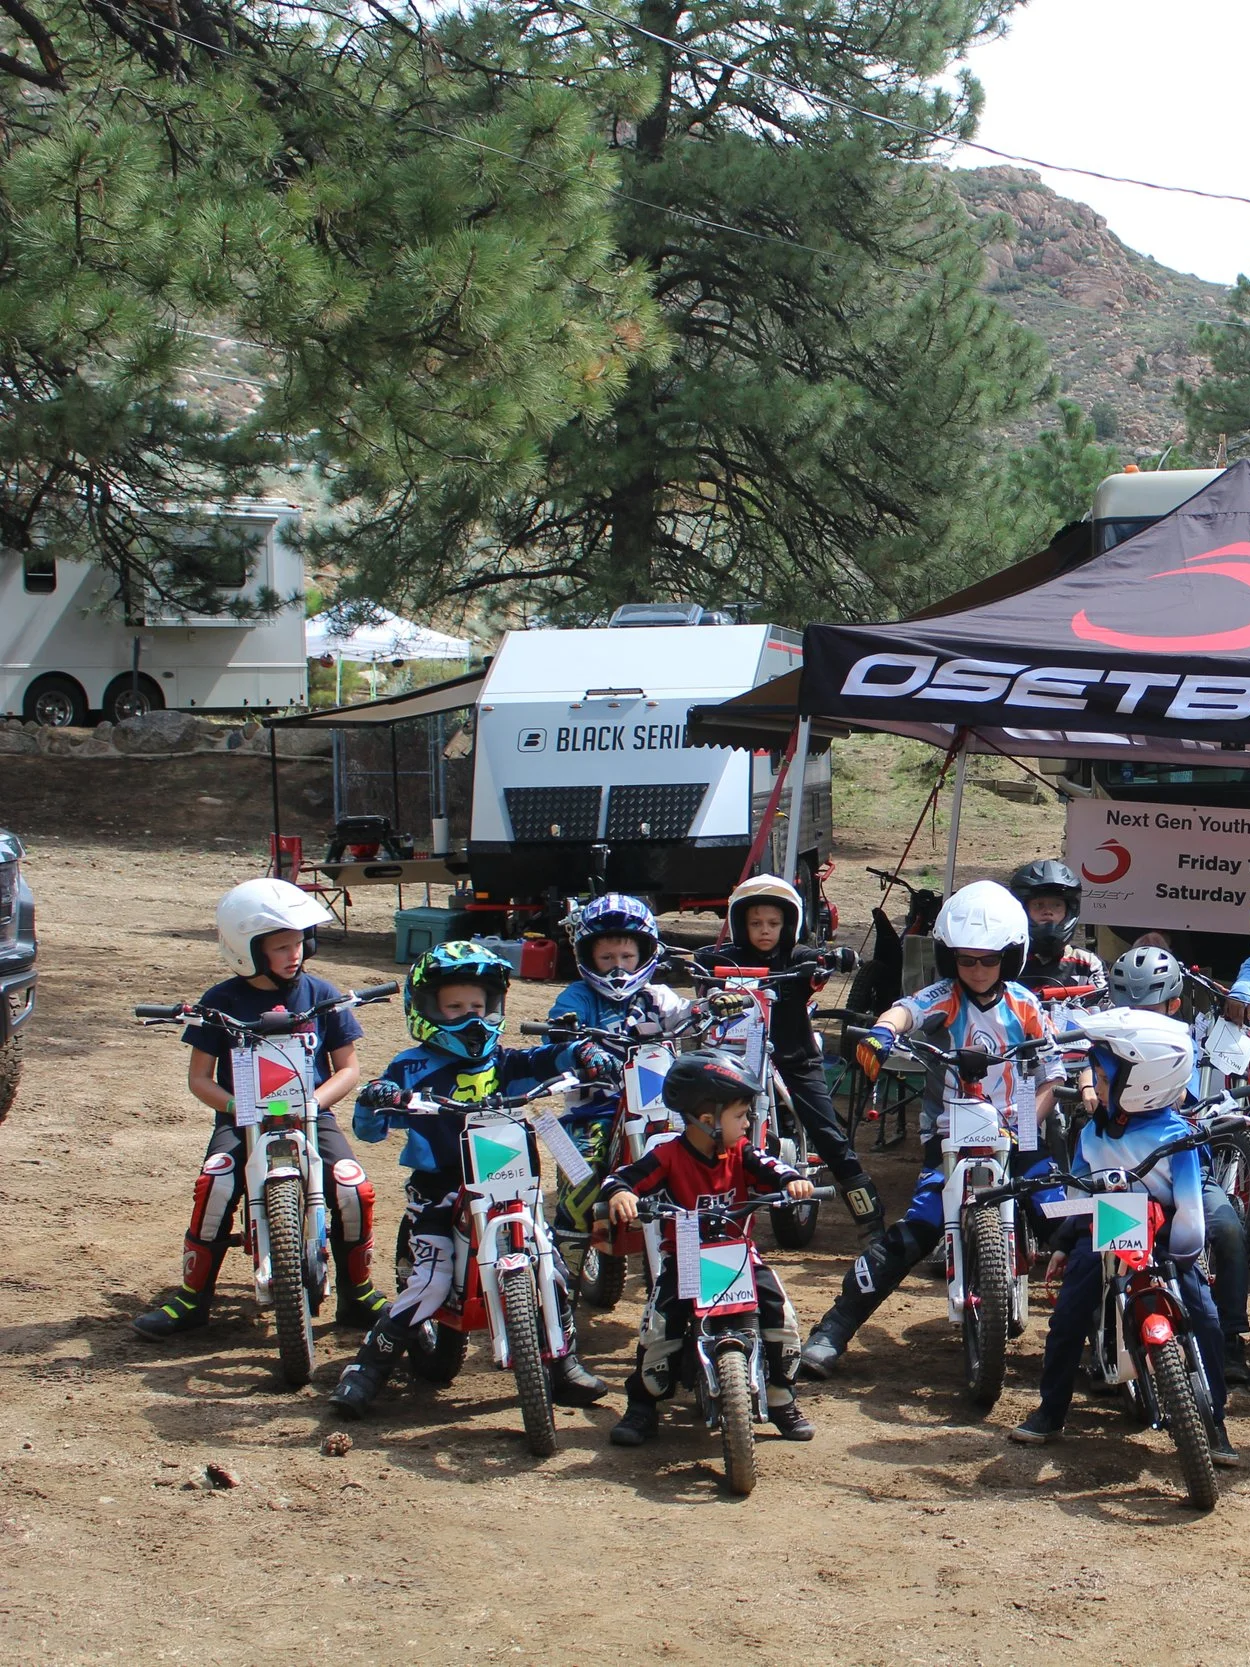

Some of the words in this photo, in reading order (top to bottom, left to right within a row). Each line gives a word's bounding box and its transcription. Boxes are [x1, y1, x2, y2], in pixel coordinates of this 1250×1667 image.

[556, 726, 625, 752] BLACK
[1106, 809, 1150, 828] Next
[1154, 812, 1193, 831] Gen
[1178, 853, 1243, 876] Friday
[1155, 882, 1247, 907] Saturday
[963, 1134, 998, 1144] CARSON
[487, 1168, 525, 1182] ROBBIE
[1109, 1238, 1143, 1250] ADAM
[711, 1289, 754, 1304] CANYON
